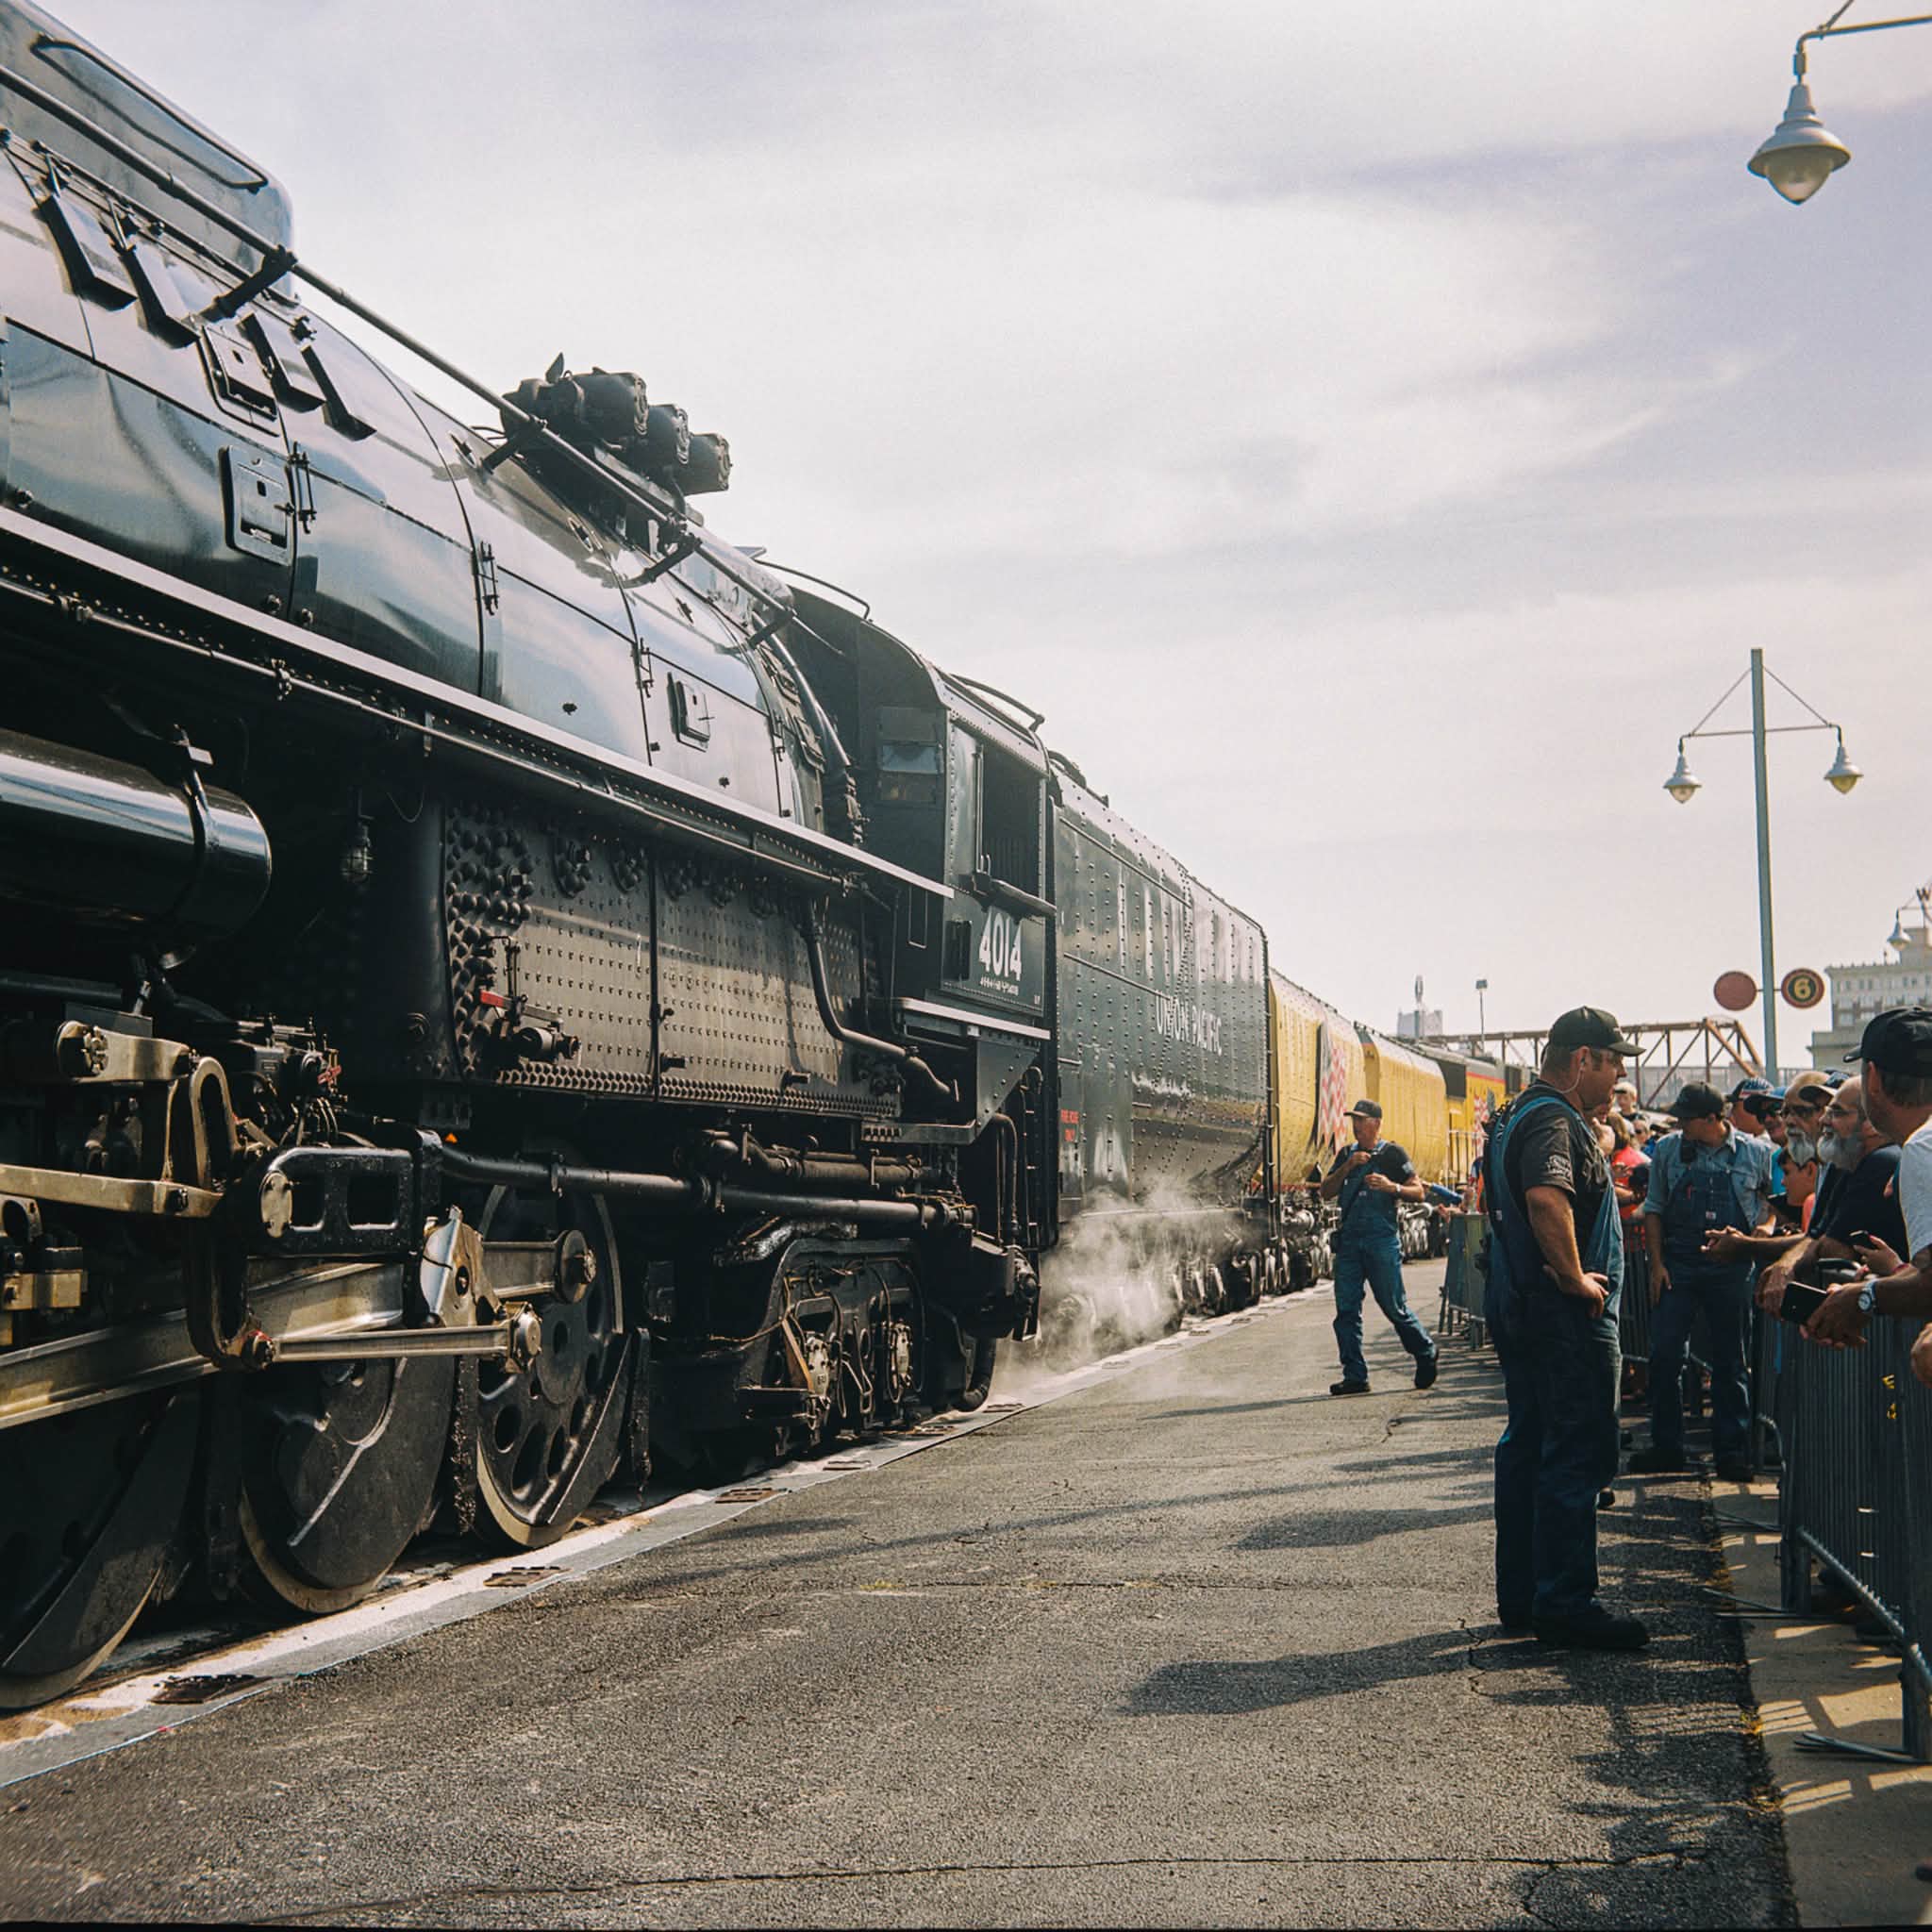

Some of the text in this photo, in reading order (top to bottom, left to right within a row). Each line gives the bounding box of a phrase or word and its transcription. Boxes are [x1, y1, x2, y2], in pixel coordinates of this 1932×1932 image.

[978, 905, 1022, 982] 4014
[1794, 978, 1811, 999] 6
[1156, 990, 1190, 1043] UNION
